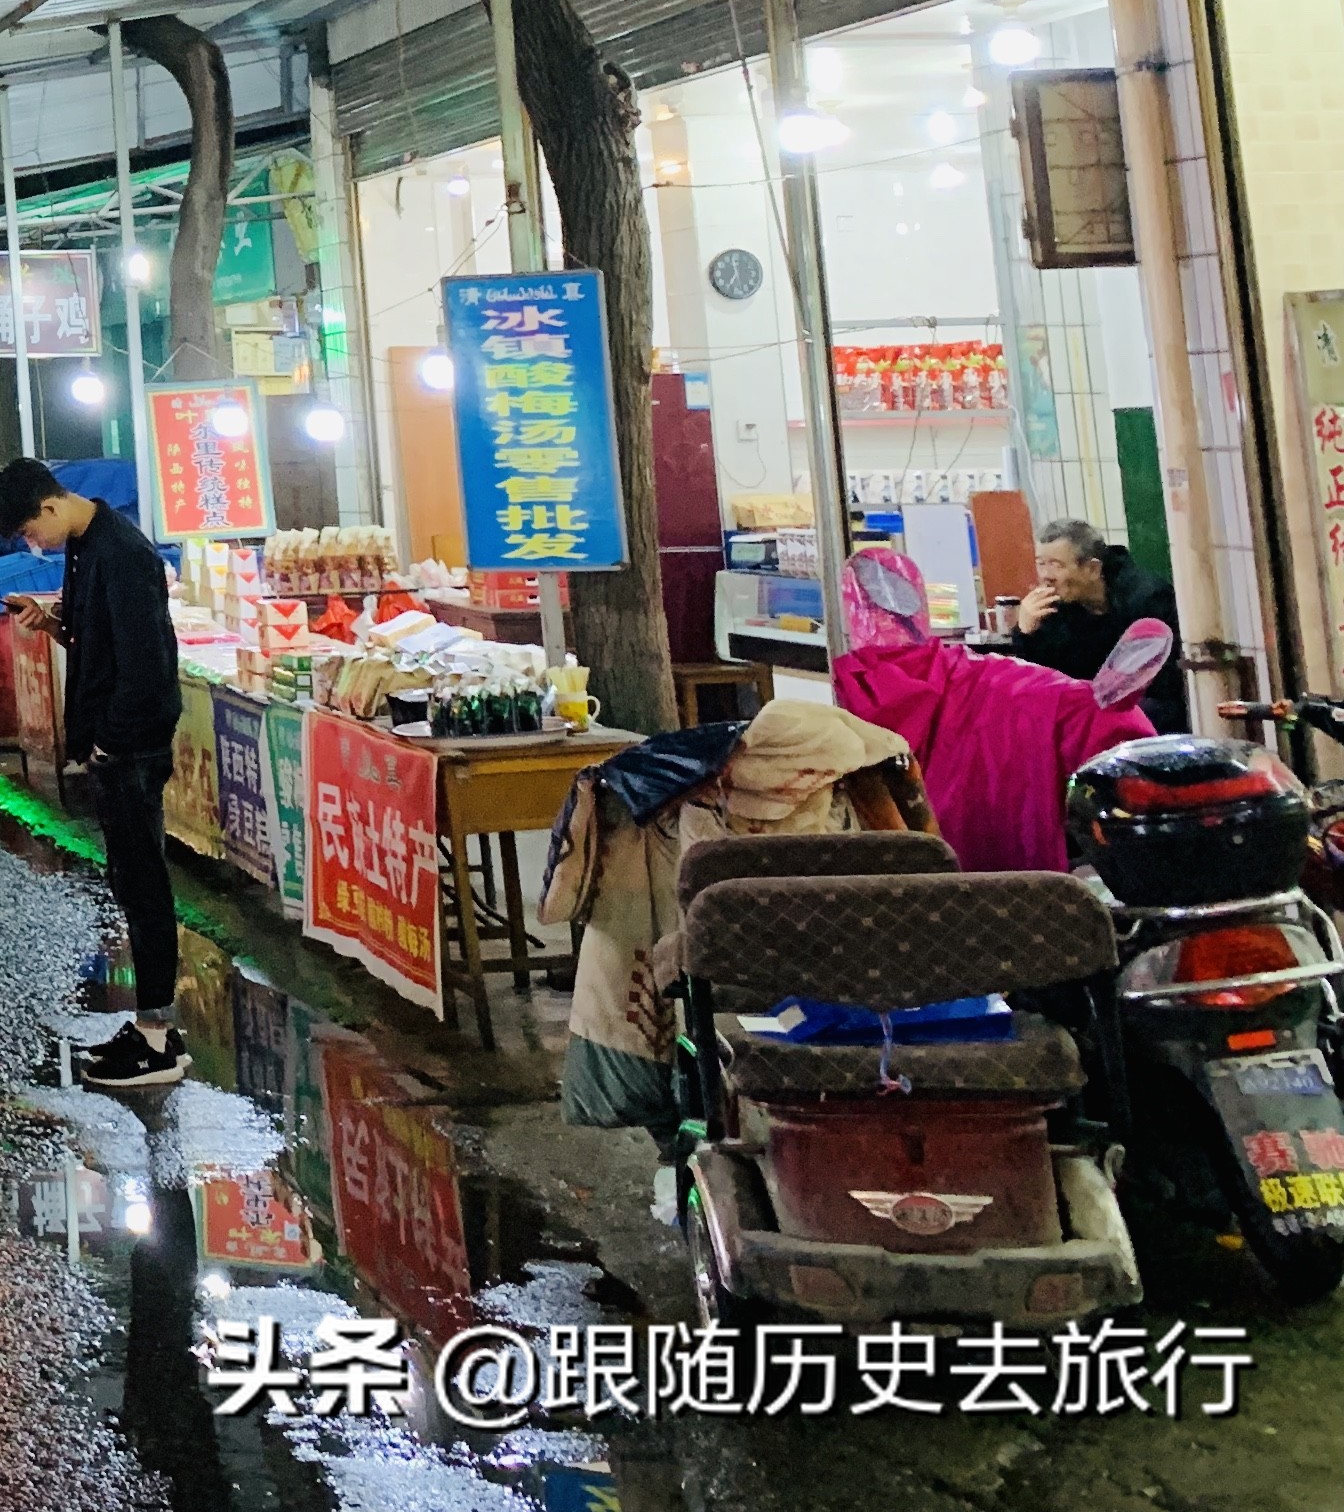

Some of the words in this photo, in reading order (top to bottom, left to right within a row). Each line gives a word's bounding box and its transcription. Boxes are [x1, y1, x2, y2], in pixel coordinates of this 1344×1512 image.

[480, 305, 590, 561] 冰镇酸梅汤零售批发
[317, 781, 439, 909] 民族土特产
